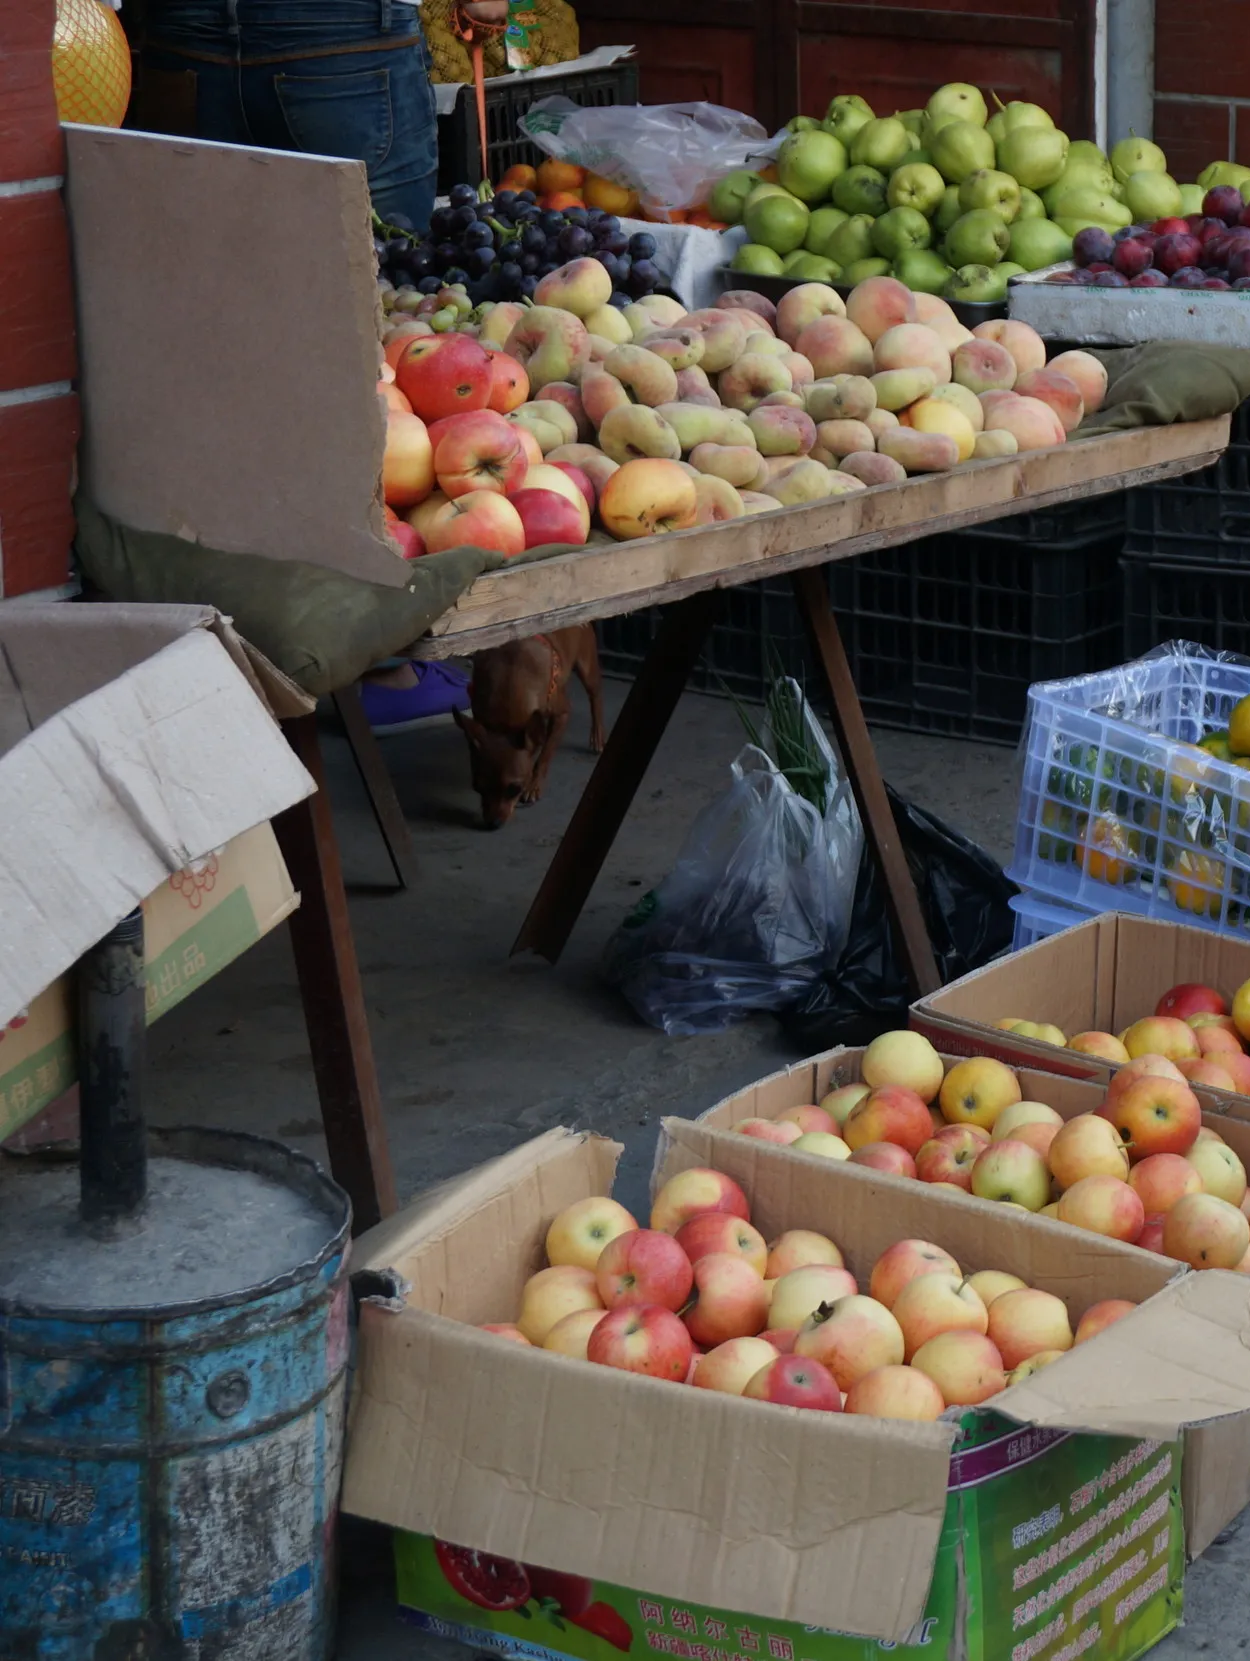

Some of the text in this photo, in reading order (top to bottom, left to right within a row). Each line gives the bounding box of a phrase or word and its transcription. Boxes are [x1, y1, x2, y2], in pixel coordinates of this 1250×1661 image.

[639, 1599, 794, 1660] 阿纳尔古丽
